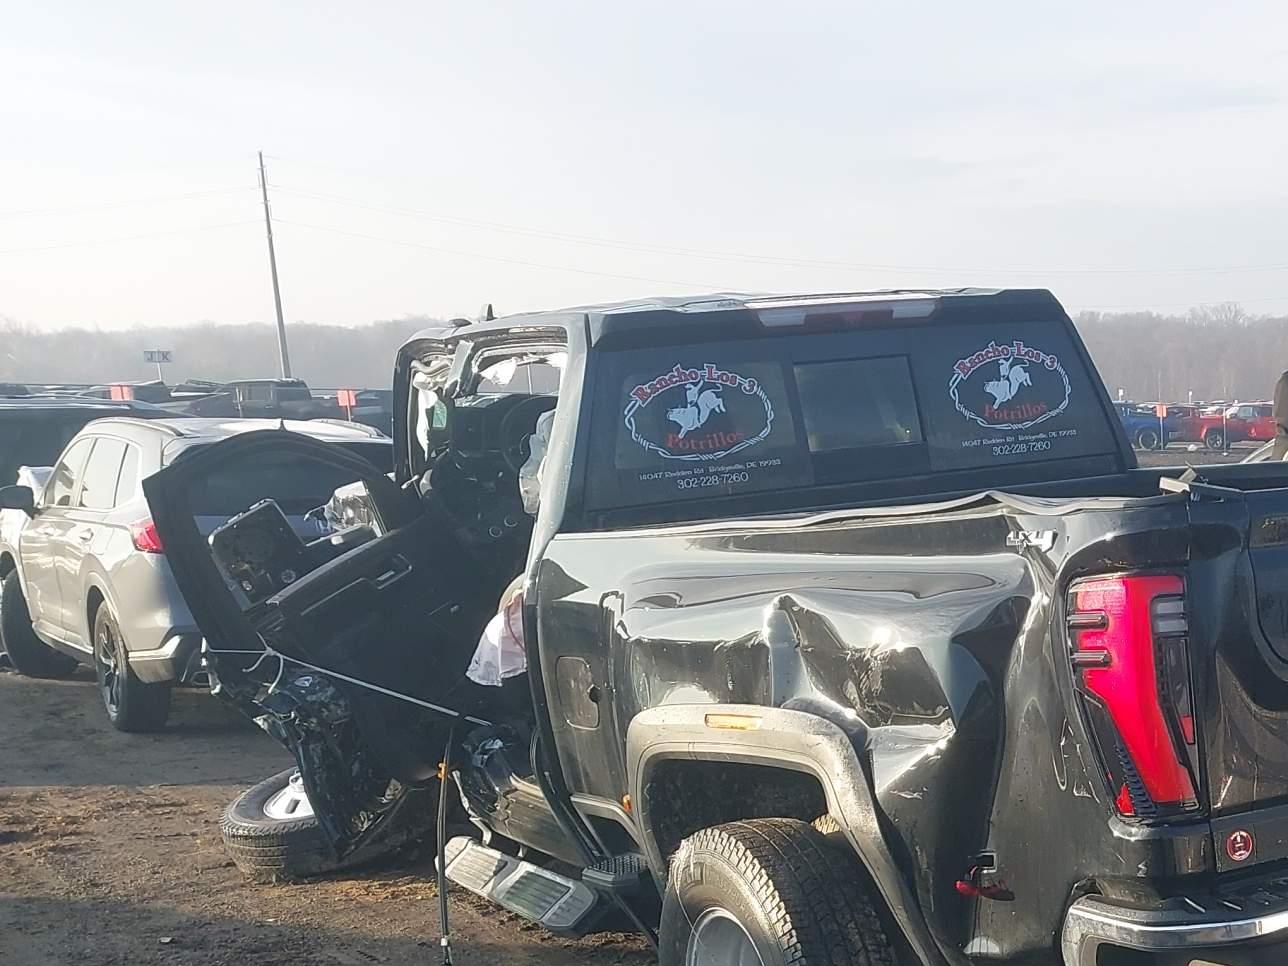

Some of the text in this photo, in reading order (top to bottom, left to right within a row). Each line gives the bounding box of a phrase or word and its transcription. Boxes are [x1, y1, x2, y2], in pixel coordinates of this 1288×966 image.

[953, 341, 1059, 381] Rancho Los 3
[630, 363, 758, 408] Rancho Los 3
[984, 401, 1048, 421] Potrillos
[666, 431, 745, 450] Potrillos
[992, 441, 1051, 456] 302-228-7260
[677, 473, 748, 489] 302-228-7260
